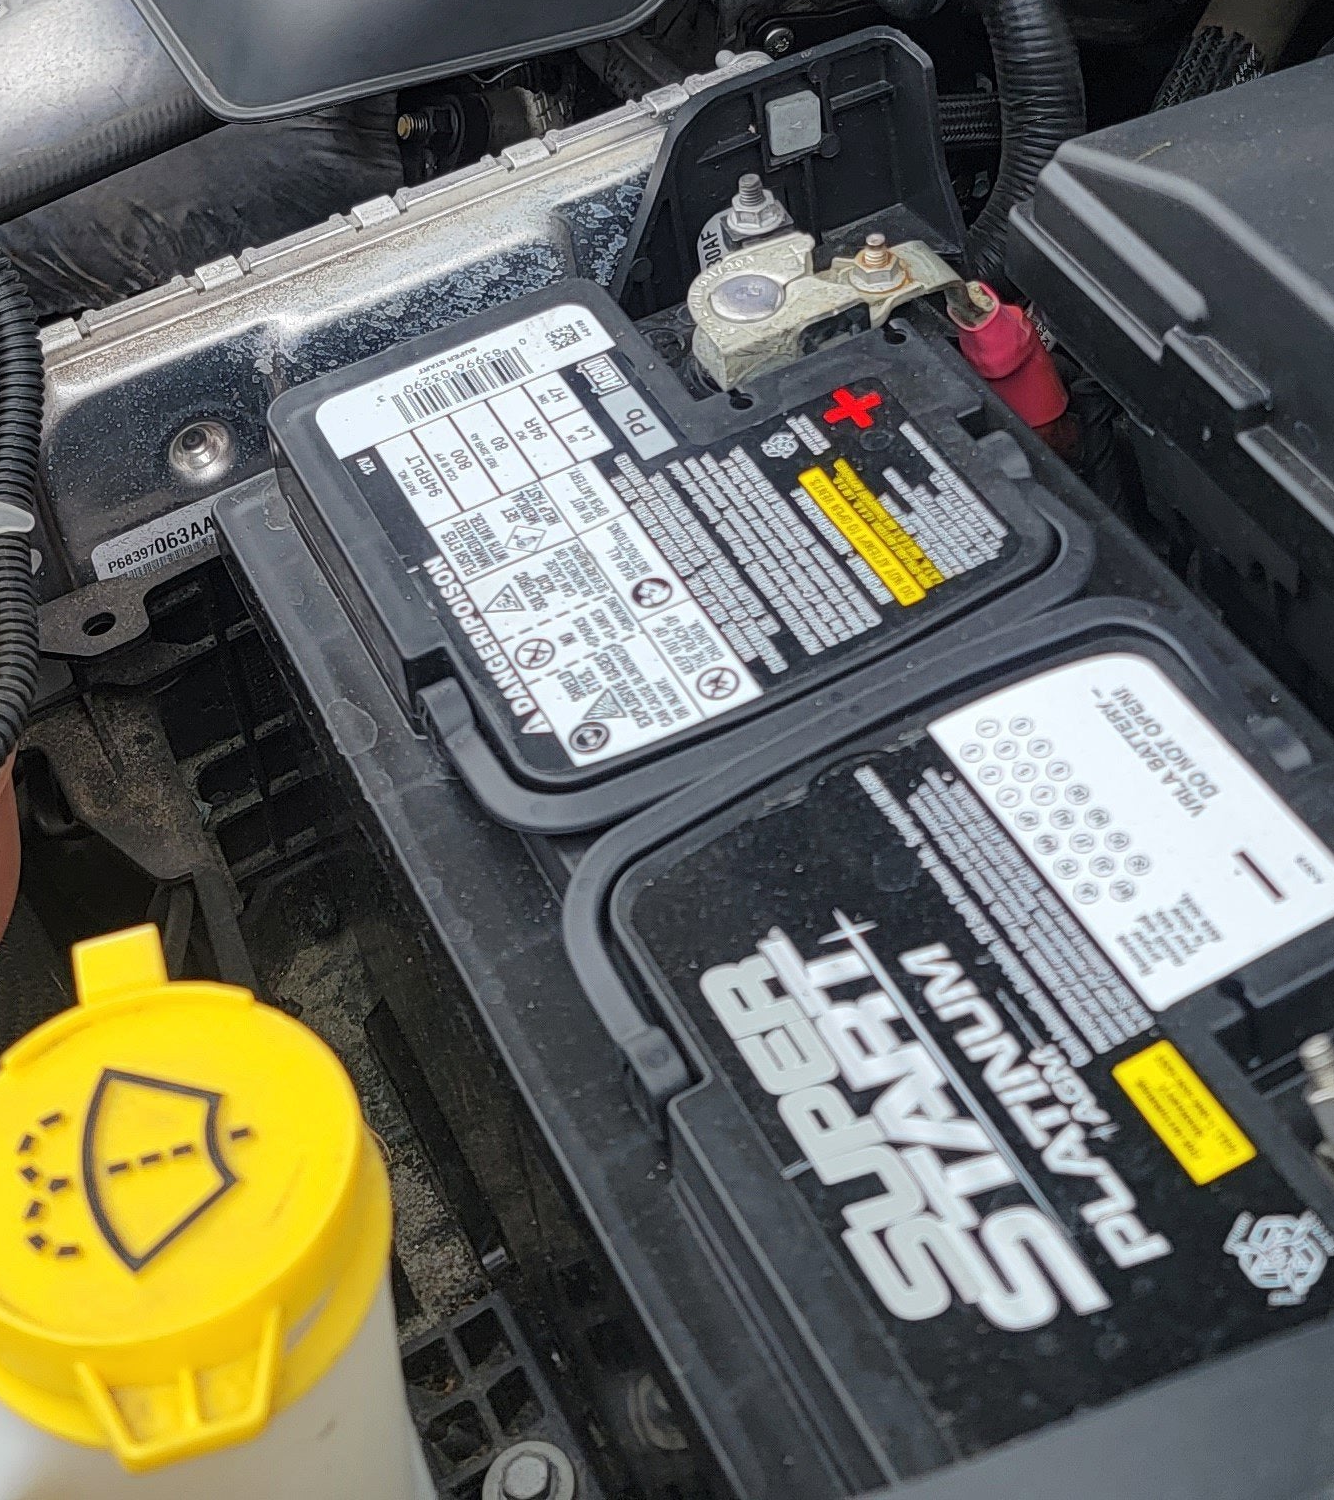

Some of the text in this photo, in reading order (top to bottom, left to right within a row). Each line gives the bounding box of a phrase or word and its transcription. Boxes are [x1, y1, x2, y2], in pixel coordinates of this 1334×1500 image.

[376, 337, 527, 402] 0 83996 03290 3
[416, 345, 478, 374] SUPER START
[581, 356, 623, 393] AGM
[546, 384, 568, 403] H7
[489, 435, 509, 451] 80
[522, 416, 548, 441] 94R
[575, 423, 596, 440] L4
[618, 406, 656, 437] Pb
[355, 454, 378, 476] 12V
[404, 452, 443, 498] 94RPLT
[449, 447, 473, 470] 800
[396, 469, 420, 496] PART NO.
[566, 467, 610, 517] OPEN BATTERY.
[500, 506, 521, 523] GET
[509, 490, 542, 526] MEDICAL
[523, 483, 561, 527] HELP FAST.
[569, 496, 596, 523] DO NOT
[107, 515, 216, 574] P68397063AA
[440, 529, 479, 577] FLUSH EYES
[451, 517, 495, 570] IMMEDIATELY
[466, 511, 510, 563] WITH WATER.
[604, 519, 652, 575] INSTRUCTIONS.
[806, 476, 916, 599] DO NOT ATTEMPT TO OPEN VENTS.
[534, 572, 557, 595] ACID
[543, 558, 577, 598] CAN CAUSE
[553, 547, 595, 597] BLINDNESS OR
[604, 545, 638, 581] READ ALL
[511, 570, 548, 612] SULFURIC
[421, 553, 537, 717] DANGER/POISON
[558, 631, 578, 646] NO
[650, 624, 696, 676] KEEP OUT OF
[662, 613, 709, 668] THE REACH OF
[685, 618, 725, 662] CHILDREN.
[556, 669, 587, 702] SHIELD
[575, 665, 603, 694] EYES.
[592, 651, 654, 729] EXPLOSIVE GASES
[609, 643, 674, 727] CAN CAUSE BLINDNESS
[652, 676, 691, 720] OR INJURY.
[1095, 697, 1207, 818] VRLA BATTERY
[1110, 684, 1220, 800] DO NOT OPEN!
[897, 942, 1173, 1269] PLATINUM
[1033, 1042, 1119, 1130] AGM
[700, 952, 978, 1322] SUPER
[757, 930, 1113, 1333] START
